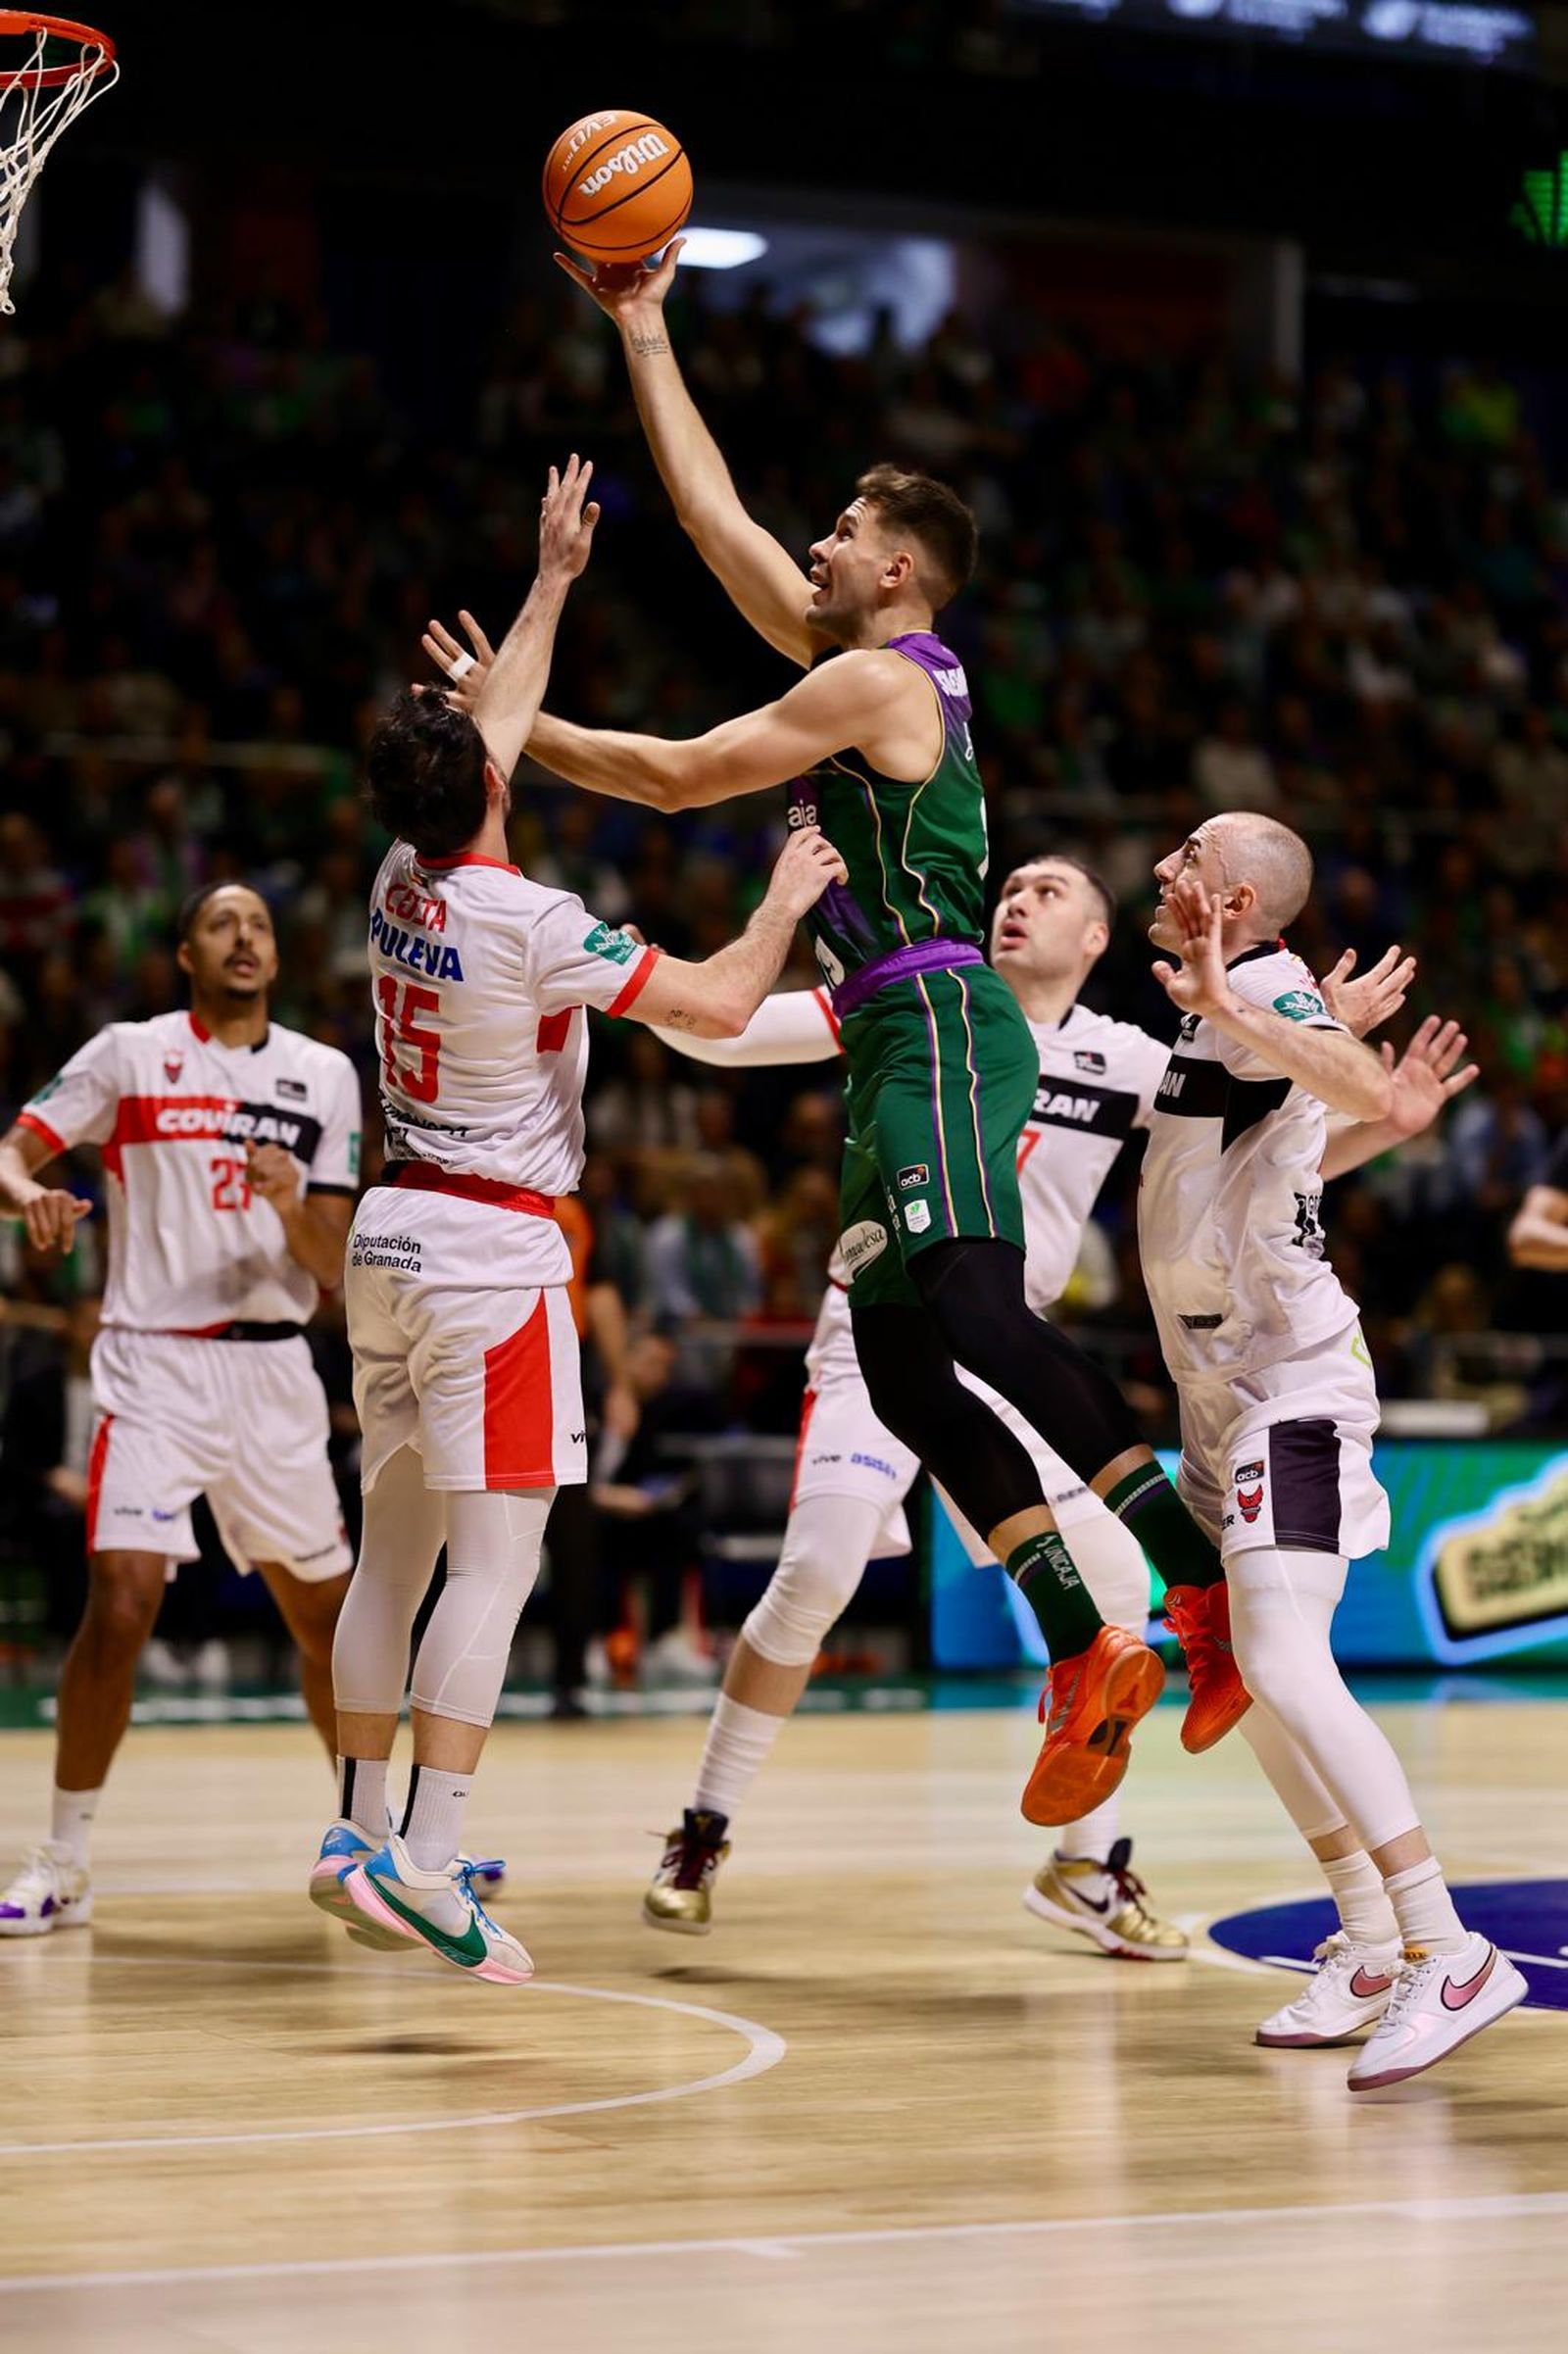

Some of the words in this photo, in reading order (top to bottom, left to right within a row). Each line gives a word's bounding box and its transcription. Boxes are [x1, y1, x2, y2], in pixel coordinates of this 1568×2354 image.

[578, 133, 669, 196] Wilson
[787, 799, 817, 827] aja
[371, 907, 465, 983] PULEVA
[378, 975, 441, 1104] 15
[1158, 1070, 1187, 1098] AN
[1033, 1088, 1102, 1123] RAN
[901, 1173, 922, 1188] acb
[353, 1233, 422, 1254] Diputación
[352, 1251, 363, 1267] de
[364, 1251, 422, 1273] Granada
[1236, 1470, 1258, 1482] acb
[1043, 1544, 1081, 1591] UNICAJA
